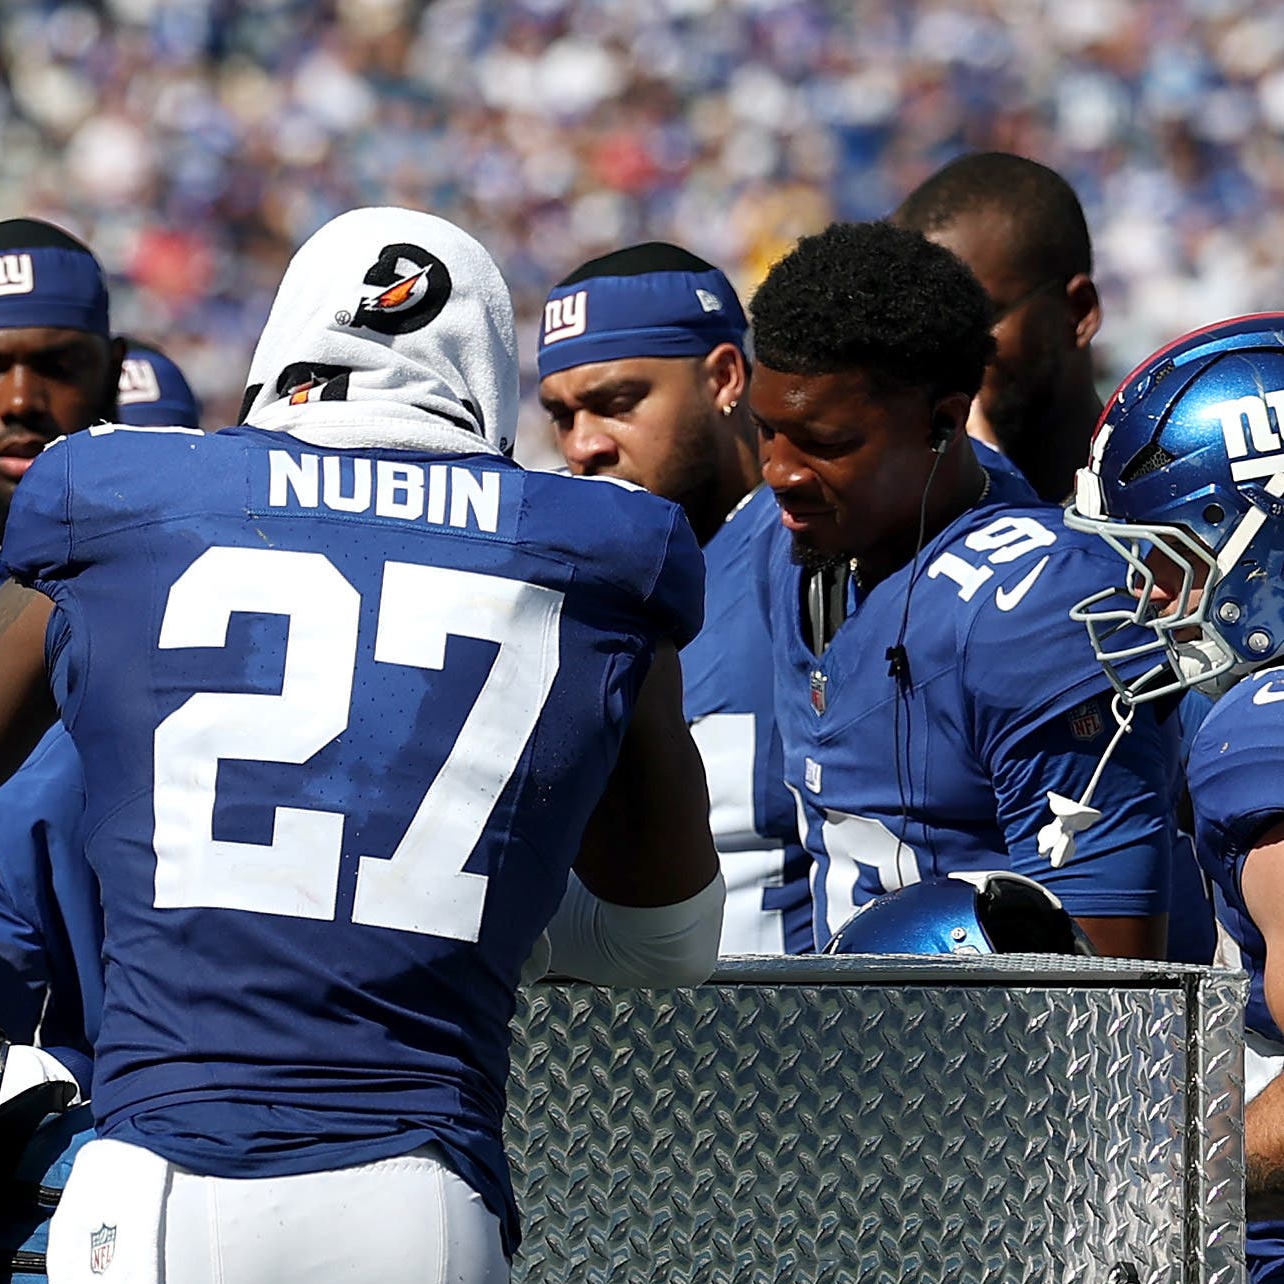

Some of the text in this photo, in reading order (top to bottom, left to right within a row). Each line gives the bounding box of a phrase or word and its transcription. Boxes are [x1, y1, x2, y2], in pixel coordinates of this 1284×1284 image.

[268, 449, 500, 534] NUBIN
[927, 516, 1058, 603] 19
[153, 545, 566, 943] 27
[1075, 714, 1100, 737] NFL
[93, 1244, 112, 1270] NFL
